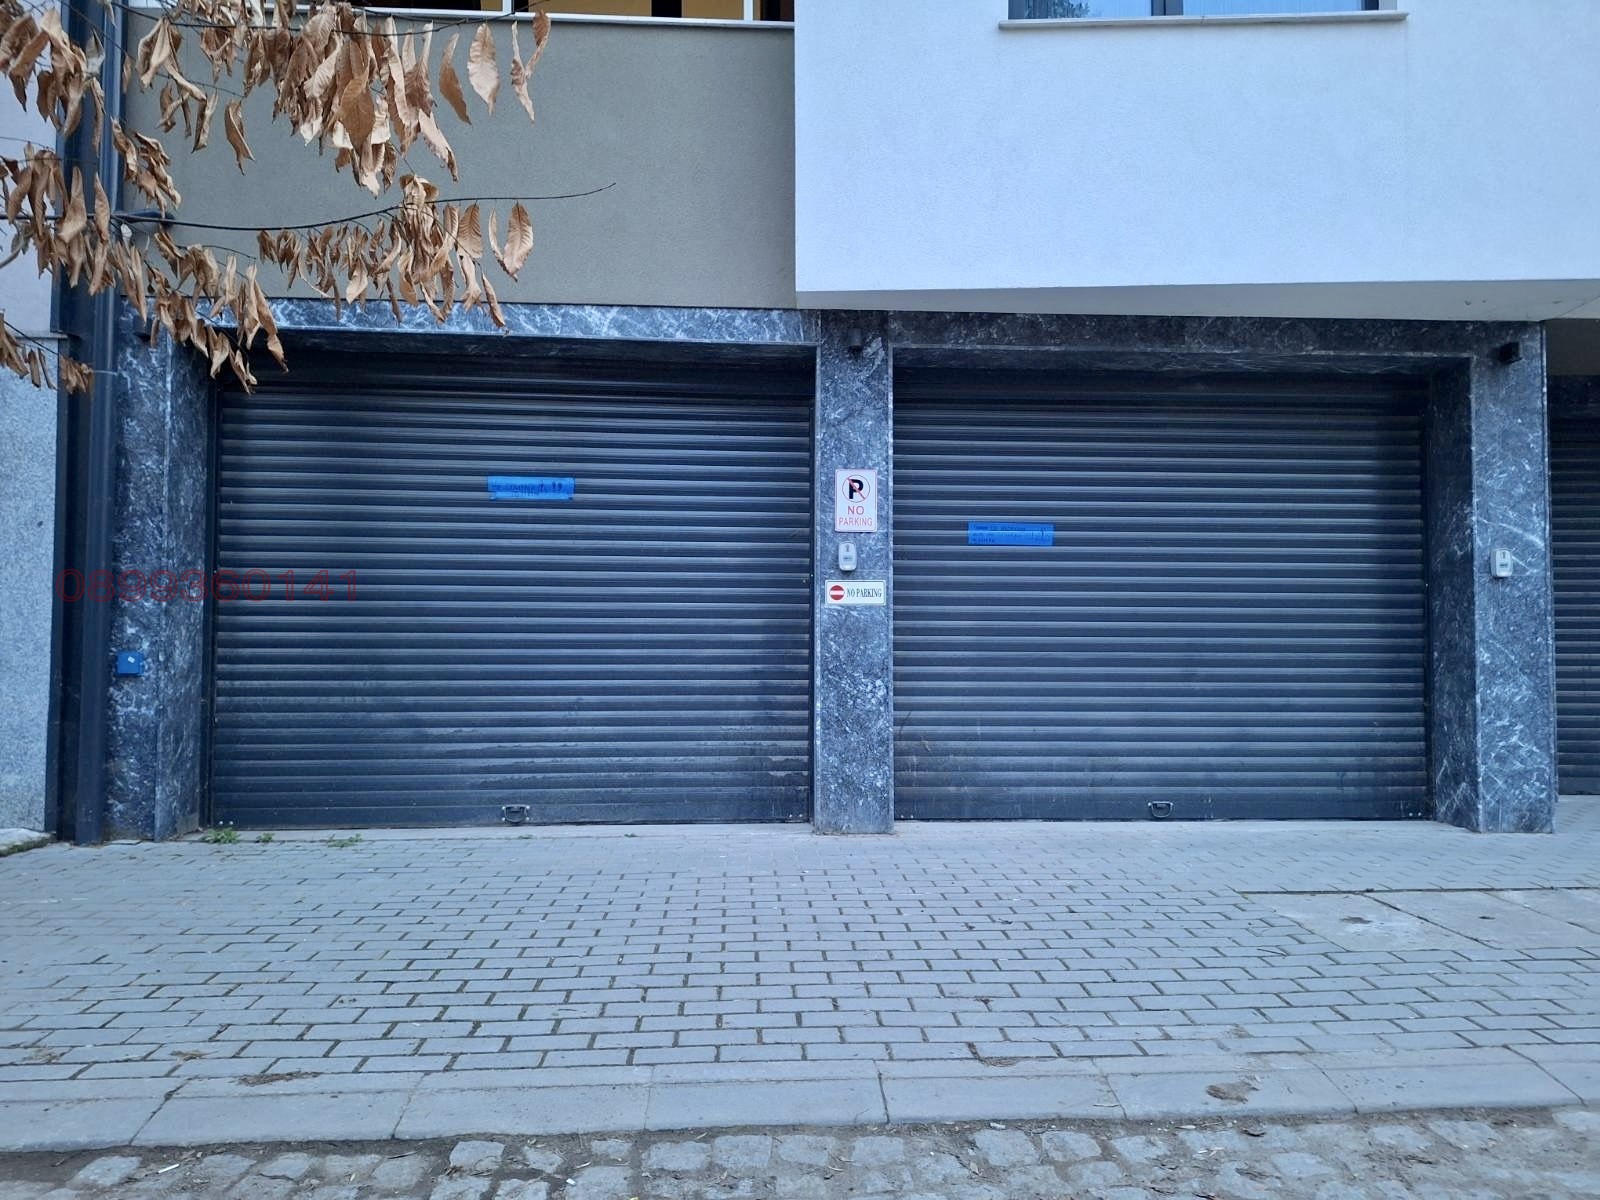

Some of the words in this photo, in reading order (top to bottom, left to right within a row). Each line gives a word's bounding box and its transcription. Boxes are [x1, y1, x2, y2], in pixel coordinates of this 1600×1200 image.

[848, 506, 865, 515] NO
[838, 517, 873, 526] PARKING
[846, 588, 856, 598] NO
[856, 588, 882, 598] PARKING
